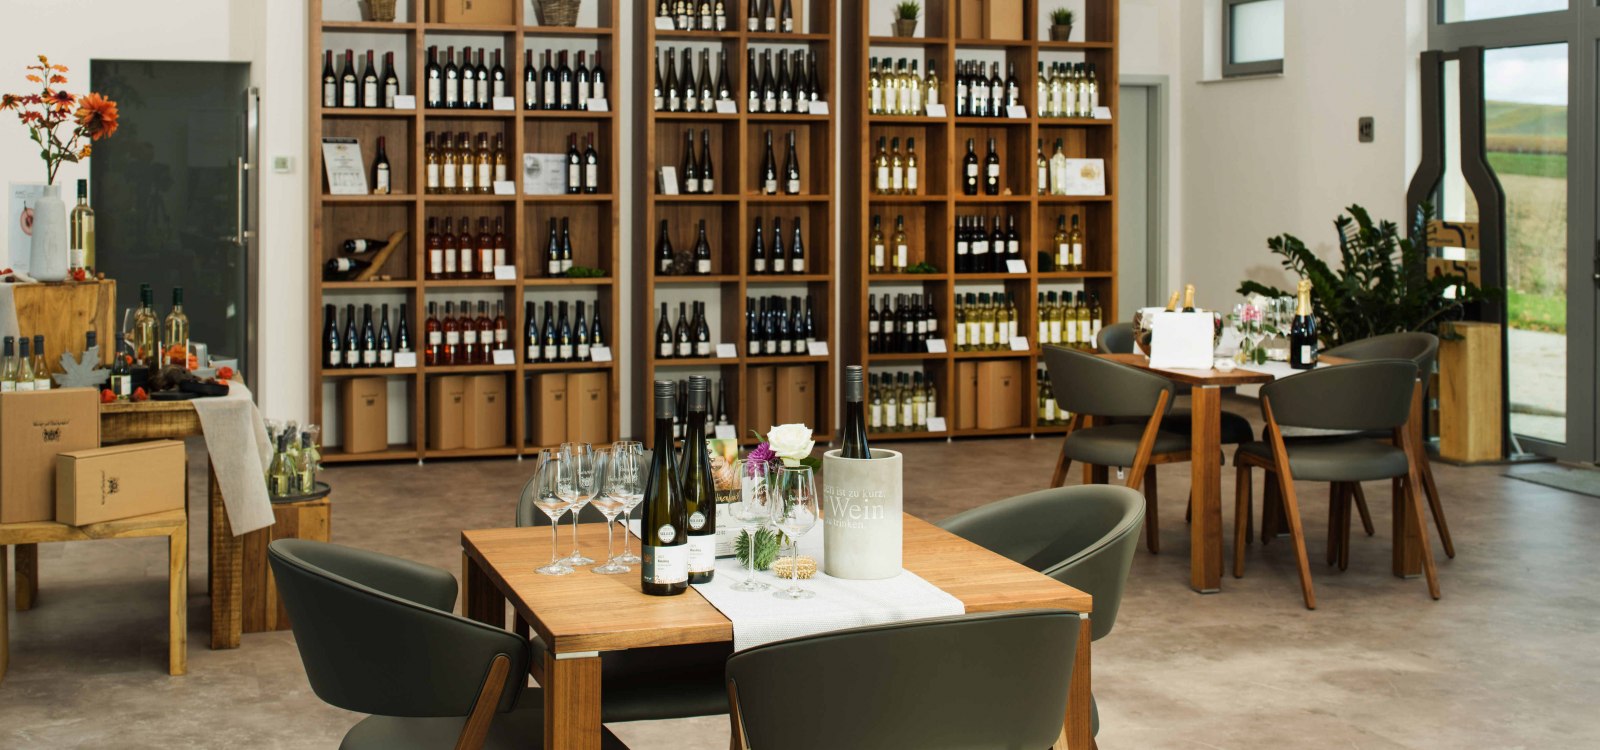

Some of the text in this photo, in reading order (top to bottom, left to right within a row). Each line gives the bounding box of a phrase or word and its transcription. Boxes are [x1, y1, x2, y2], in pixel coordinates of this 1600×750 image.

[836, 487, 846, 497] ist
[848, 489, 858, 498] zu
[829, 496, 884, 519] Wein
